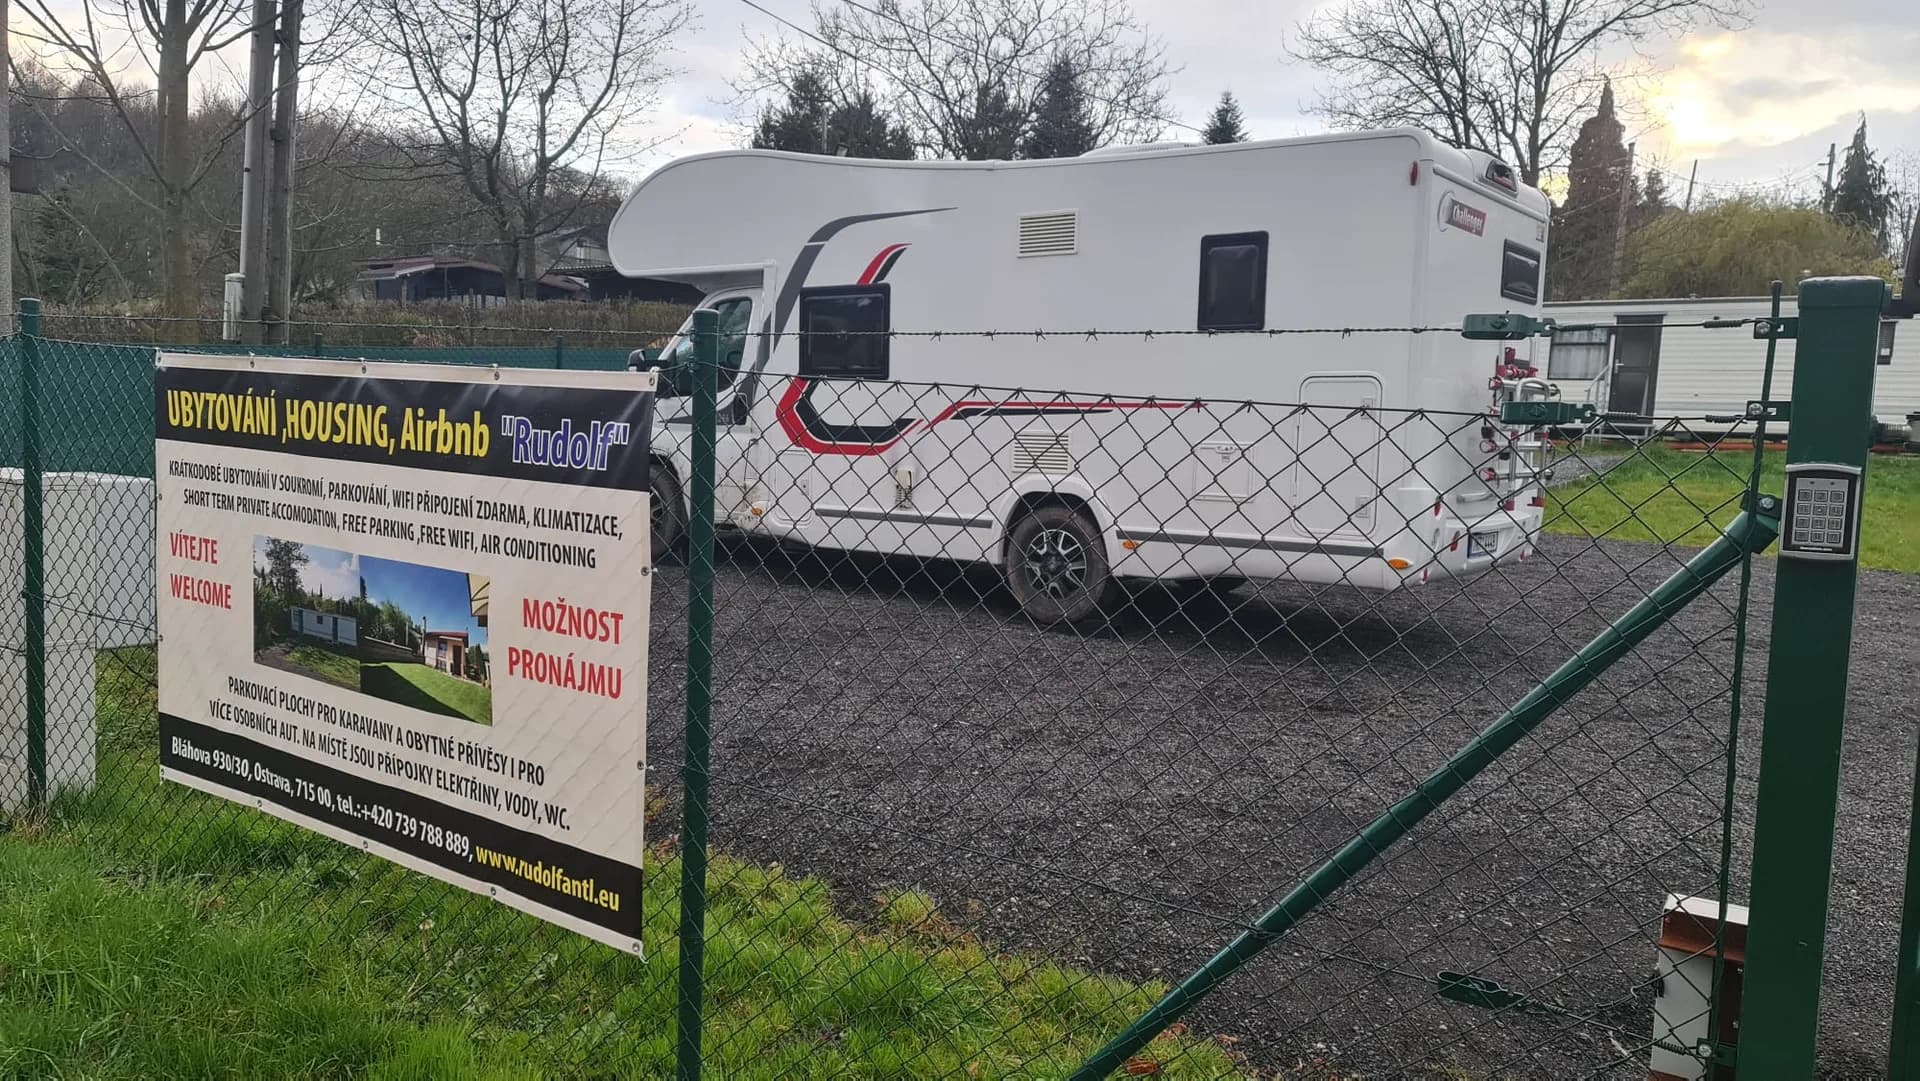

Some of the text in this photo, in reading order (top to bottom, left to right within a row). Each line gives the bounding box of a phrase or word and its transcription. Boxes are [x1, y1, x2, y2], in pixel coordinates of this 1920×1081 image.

[167, 387, 277, 436] UBYTOVÁNÍ
[401, 407, 490, 457] Airbnb
[501, 414, 630, 471] "Rudolf"
[169, 459, 623, 541] KRÁTKODOBÉ UBYTOVÁNÍ V SOUKROMÍ, PARKOVÁNÍ, WIFI PŘIPOJENÍ ZDARMA, KLIMATIZACE,
[184, 488, 211, 507] SHORT
[212, 492, 235, 512] TERM
[236, 497, 270, 517] PRIVATE
[271, 503, 341, 533] ACCOMODATION,
[342, 513, 367, 534] FREE
[369, 517, 414, 541] PARKING
[448, 529, 478, 555] WIFI,
[481, 534, 501, 555] AIR
[503, 536, 596, 569] CONDITIONING
[170, 529, 218, 564] VÍTEJTE
[170, 573, 232, 609] WELCOME
[523, 596, 624, 645] MOŽNOST
[508, 646, 622, 699] PRONÁJMU
[209, 698, 571, 831] VÍCE OSOBNÍCH AUT. NA MÍSTĚ JSOU PŘÍPOJKY ELEKTŘINY, VODY, WC.
[228, 676, 545, 786] PARKOVACÍ PLOCHY PRO KARAVANY A OBYTNÉ PŘÍVĚSY I PRO
[172, 736, 211, 767] Bláhova
[212, 749, 252, 782] 930/30,
[254, 762, 295, 798] Ostrava,
[295, 778, 316, 802] 715
[317, 785, 335, 813] 00,
[395, 809, 417, 838] 739
[419, 821, 443, 848] 788
[445, 830, 474, 864] 889,
[476, 845, 620, 912] www.rudolfantl.eu
